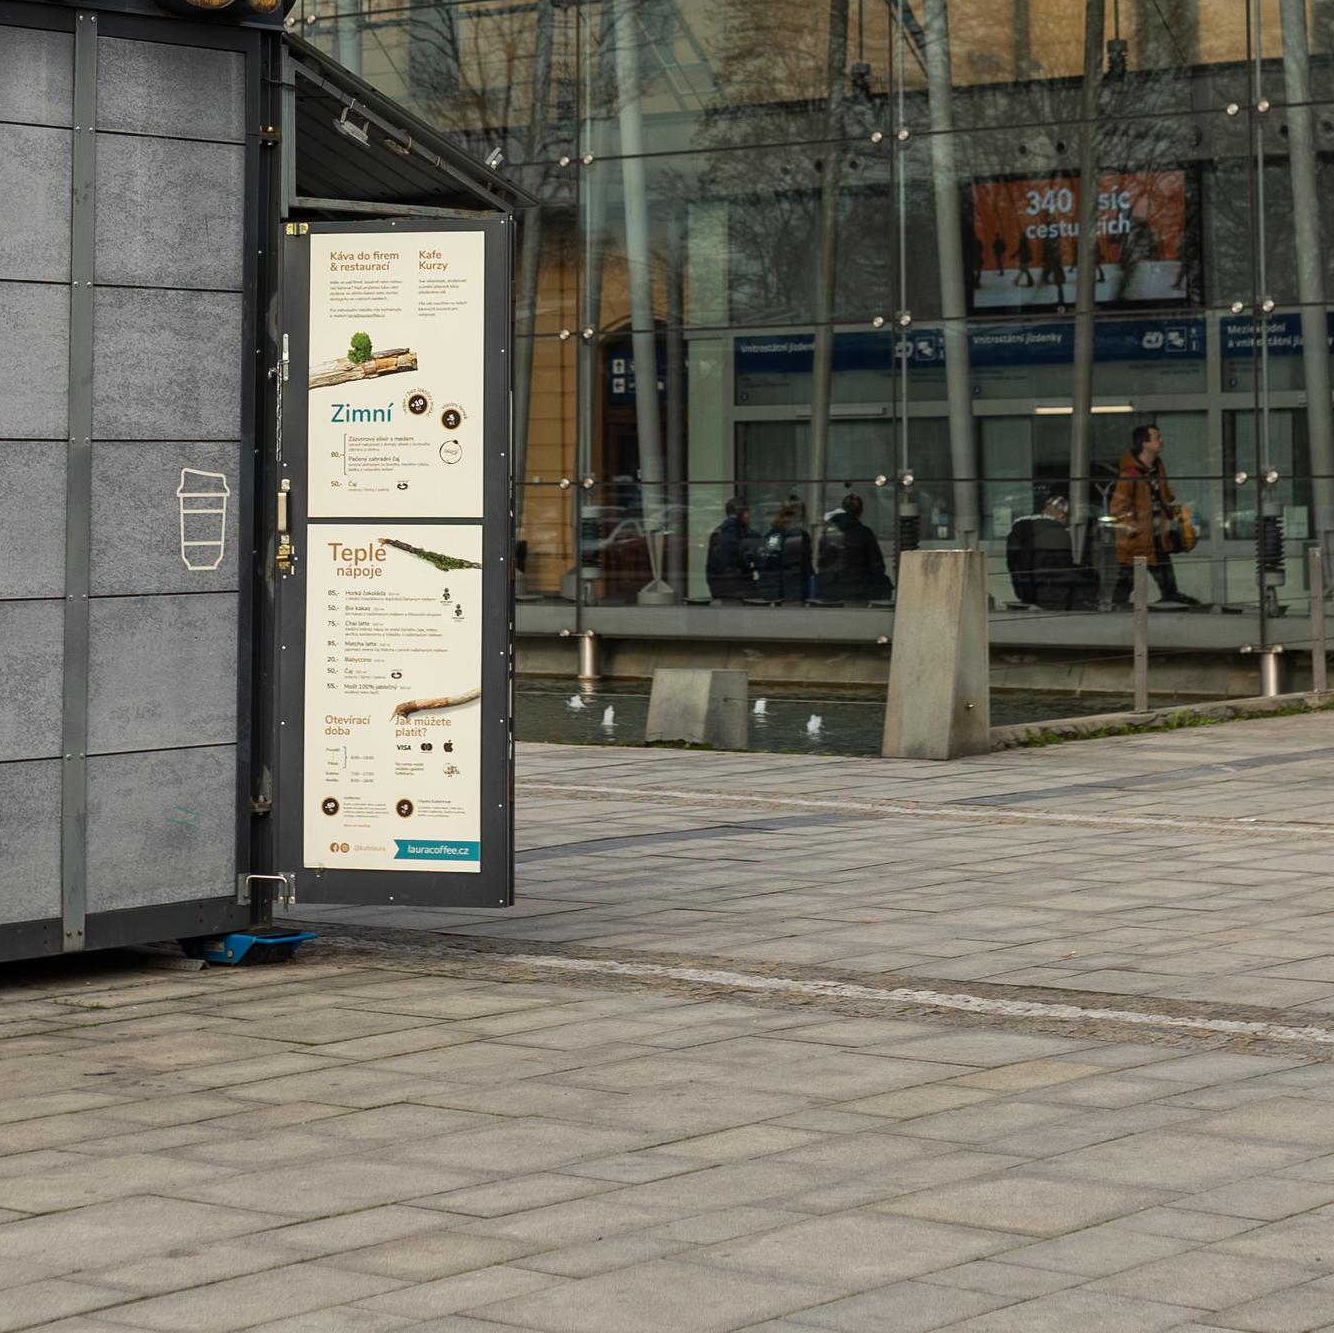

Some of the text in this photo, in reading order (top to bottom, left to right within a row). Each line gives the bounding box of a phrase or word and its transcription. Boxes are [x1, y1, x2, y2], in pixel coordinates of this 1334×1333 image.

[1026, 186, 1073, 215] 340
[330, 250, 400, 261] Káva do firem
[418, 250, 442, 260] Kafe
[330, 261, 390, 272] & restaurací
[418, 261, 448, 271] Kurzy
[331, 402, 394, 423] Zimní
[327, 542, 387, 566] Teplé
[337, 564, 383, 579] nápoje
[325, 715, 371, 725] Otevírací
[395, 717, 452, 726] Jak můžete
[325, 726, 351, 736] doba
[395, 727, 427, 738] platit?
[407, 845, 469, 856] lauracoffee.cz
